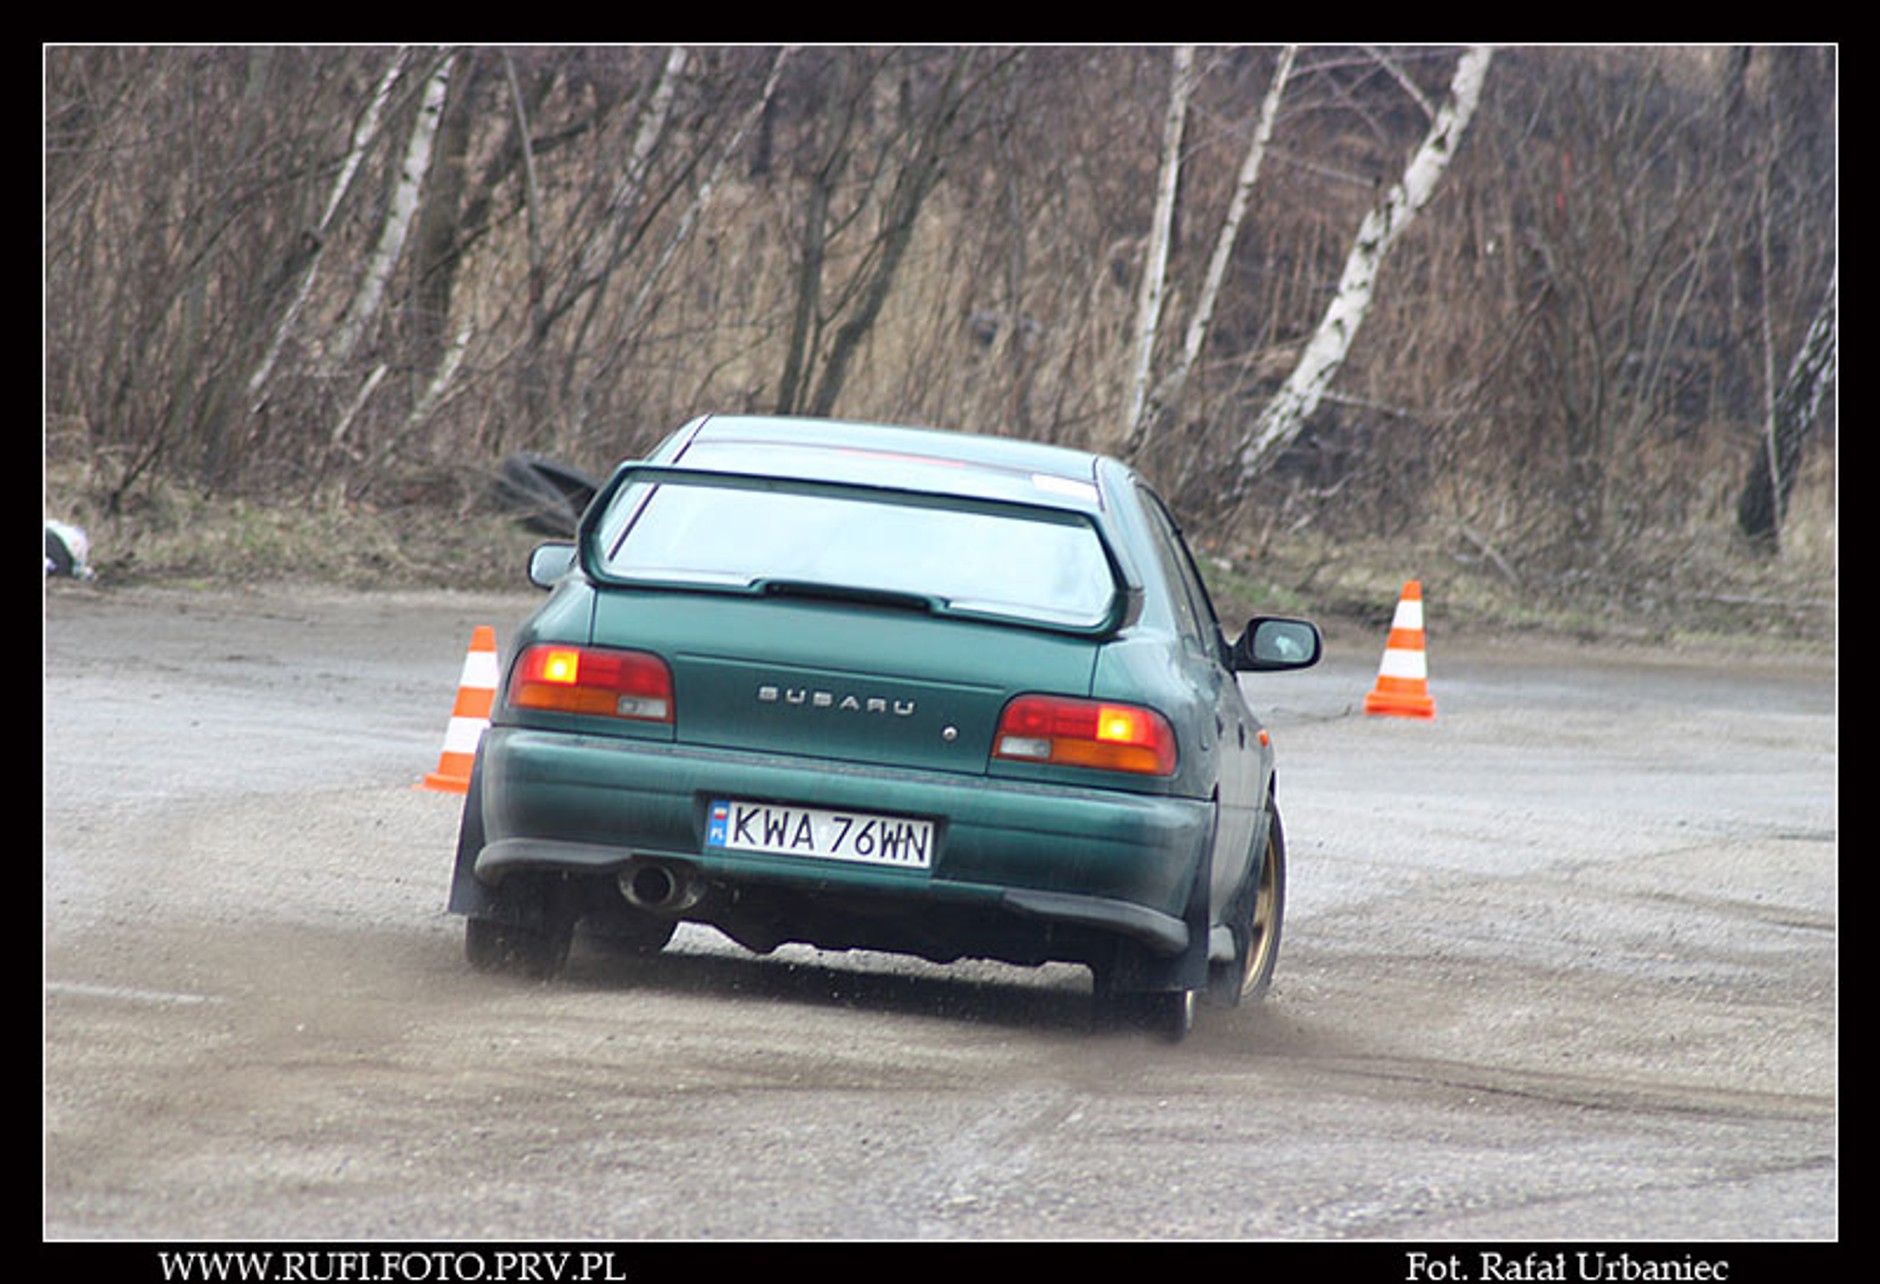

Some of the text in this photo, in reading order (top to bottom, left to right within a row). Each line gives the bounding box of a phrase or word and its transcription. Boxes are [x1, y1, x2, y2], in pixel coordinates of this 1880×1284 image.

[758, 686, 914, 715] SUBARU
[733, 806, 929, 862] KWA 76WN
